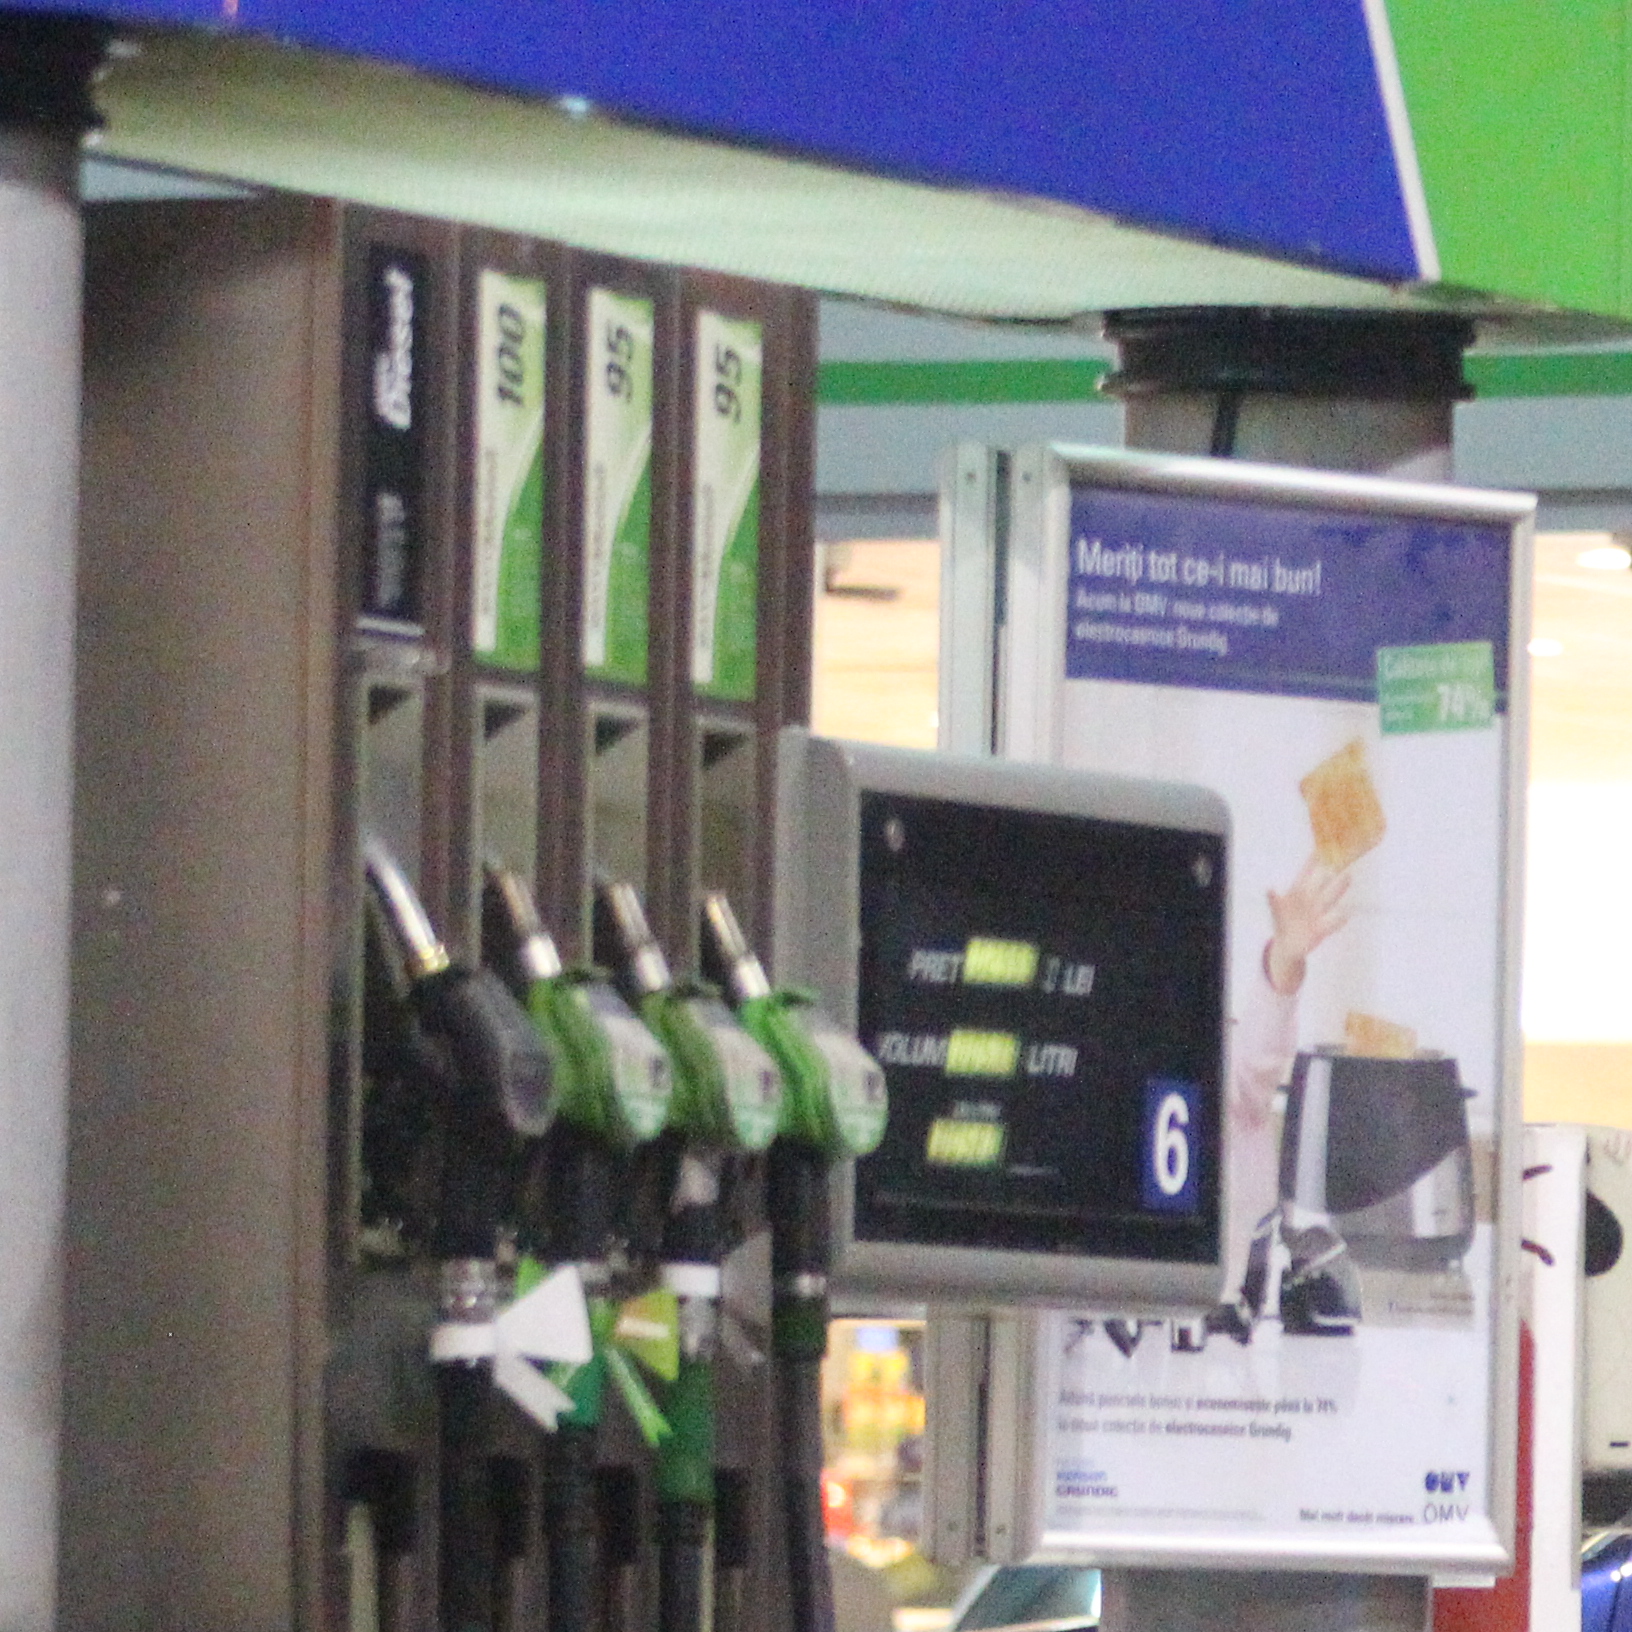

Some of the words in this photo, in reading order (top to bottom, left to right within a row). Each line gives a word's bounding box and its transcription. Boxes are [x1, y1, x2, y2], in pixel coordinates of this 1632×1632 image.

[494, 303, 526, 408] 100
[604, 321, 636, 403] 95
[713, 343, 745, 426] 95
[1149, 551, 1178, 580] tot
[1182, 552, 1225, 589] ce-i
[1229, 556, 1268, 590] mai
[1274, 558, 1322, 597] bun!
[1153, 1092, 1191, 1196] 6
[1423, 1502, 1469, 1525] OMV
